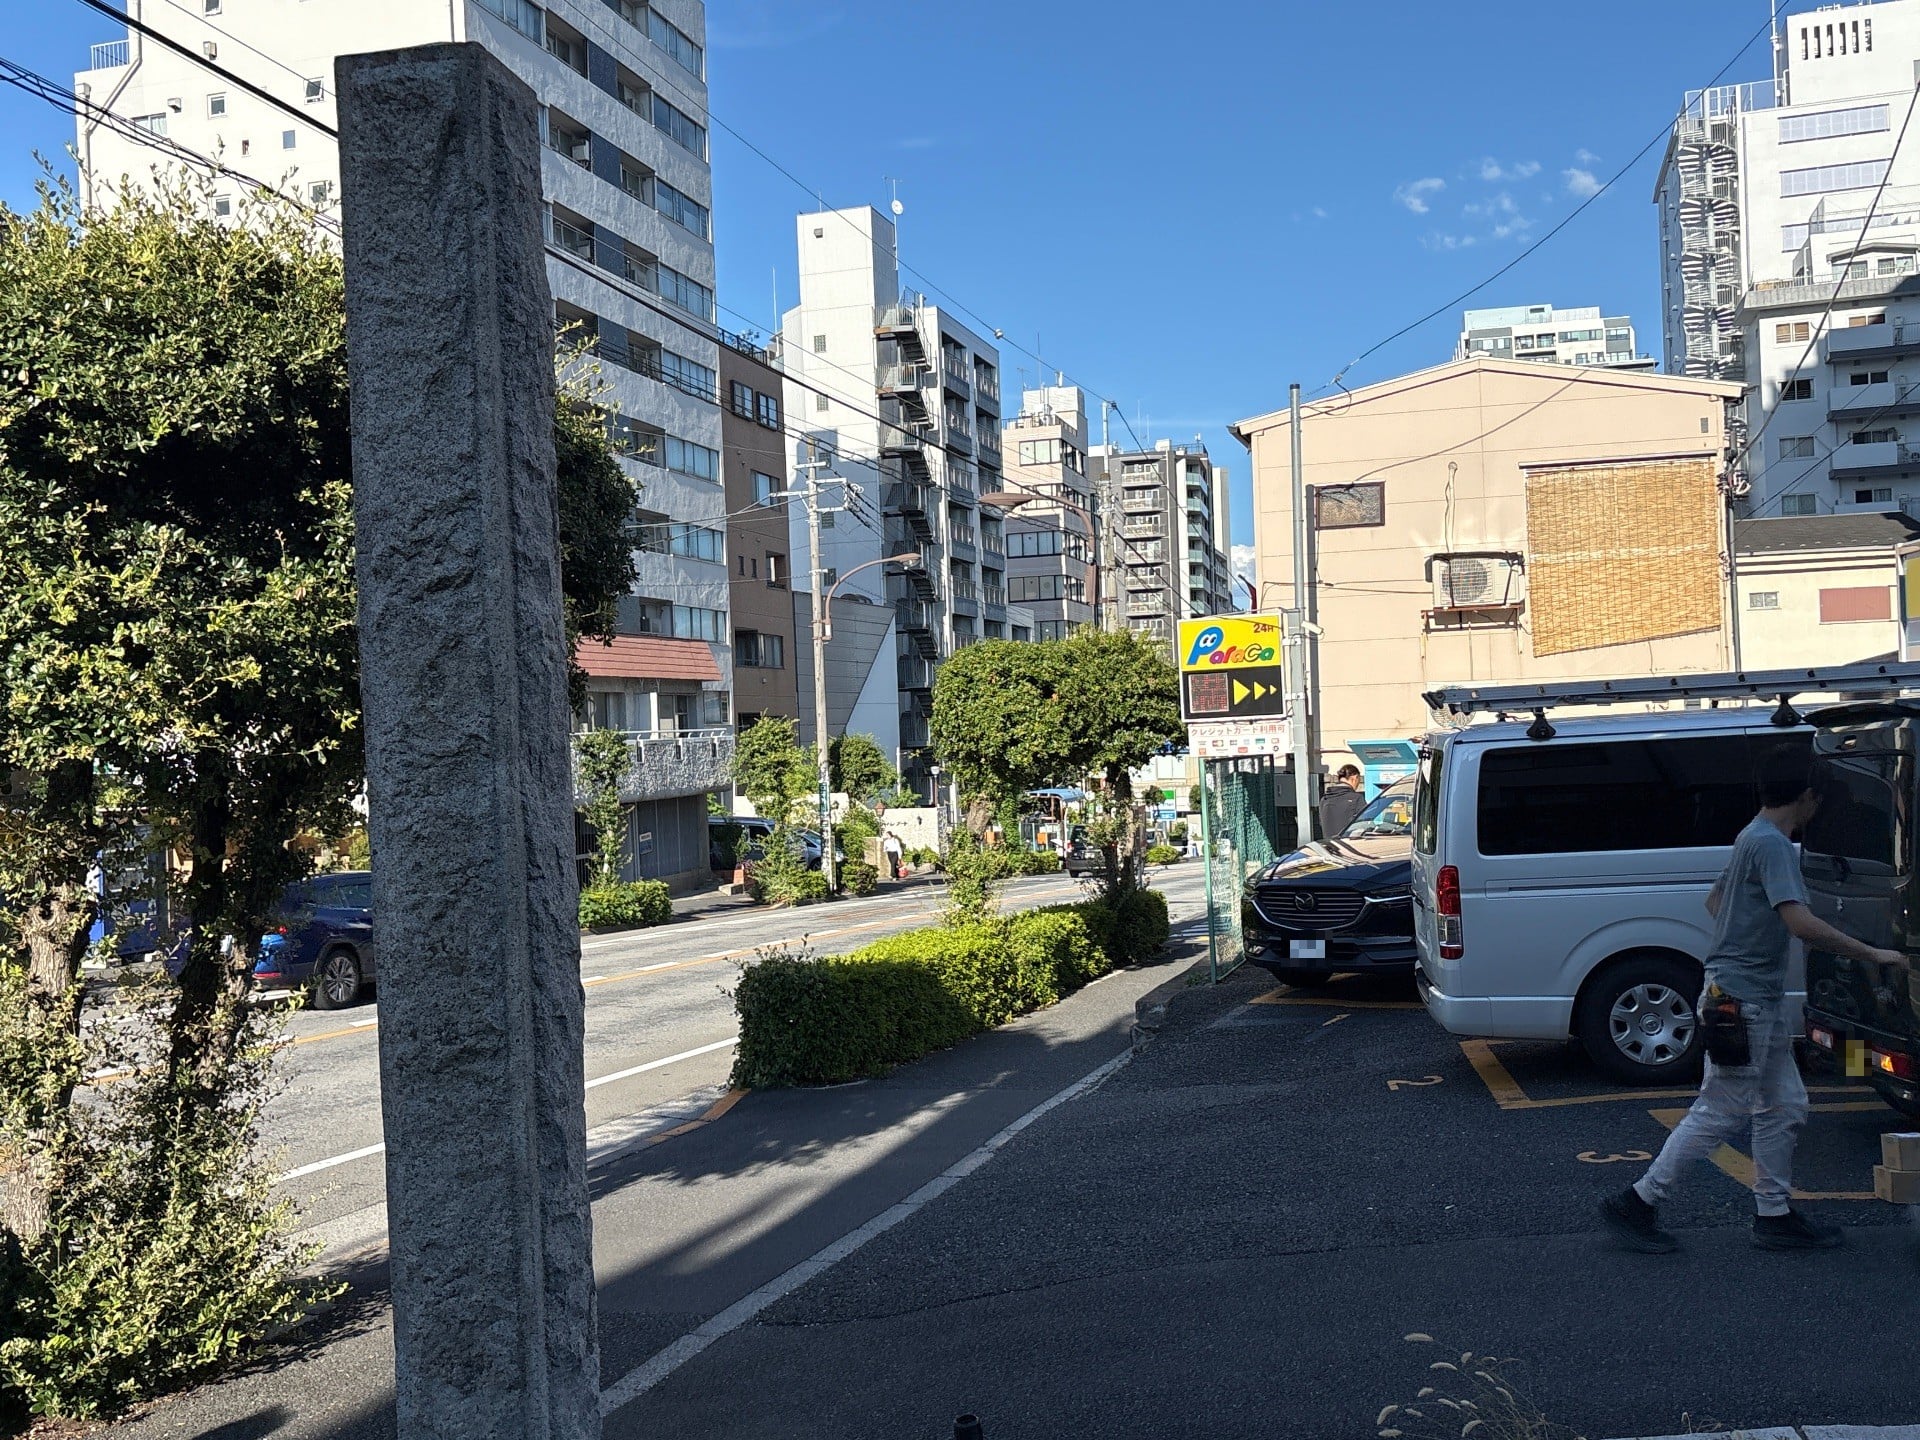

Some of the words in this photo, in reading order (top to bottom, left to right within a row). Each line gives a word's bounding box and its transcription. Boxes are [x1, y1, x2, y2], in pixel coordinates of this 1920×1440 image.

[1253, 623, 1274, 634] 24H
[1191, 724, 1286, 737] クレジットカード利用可
[1386, 1075, 1444, 1092] 2
[1575, 1149, 1653, 1164] 3
